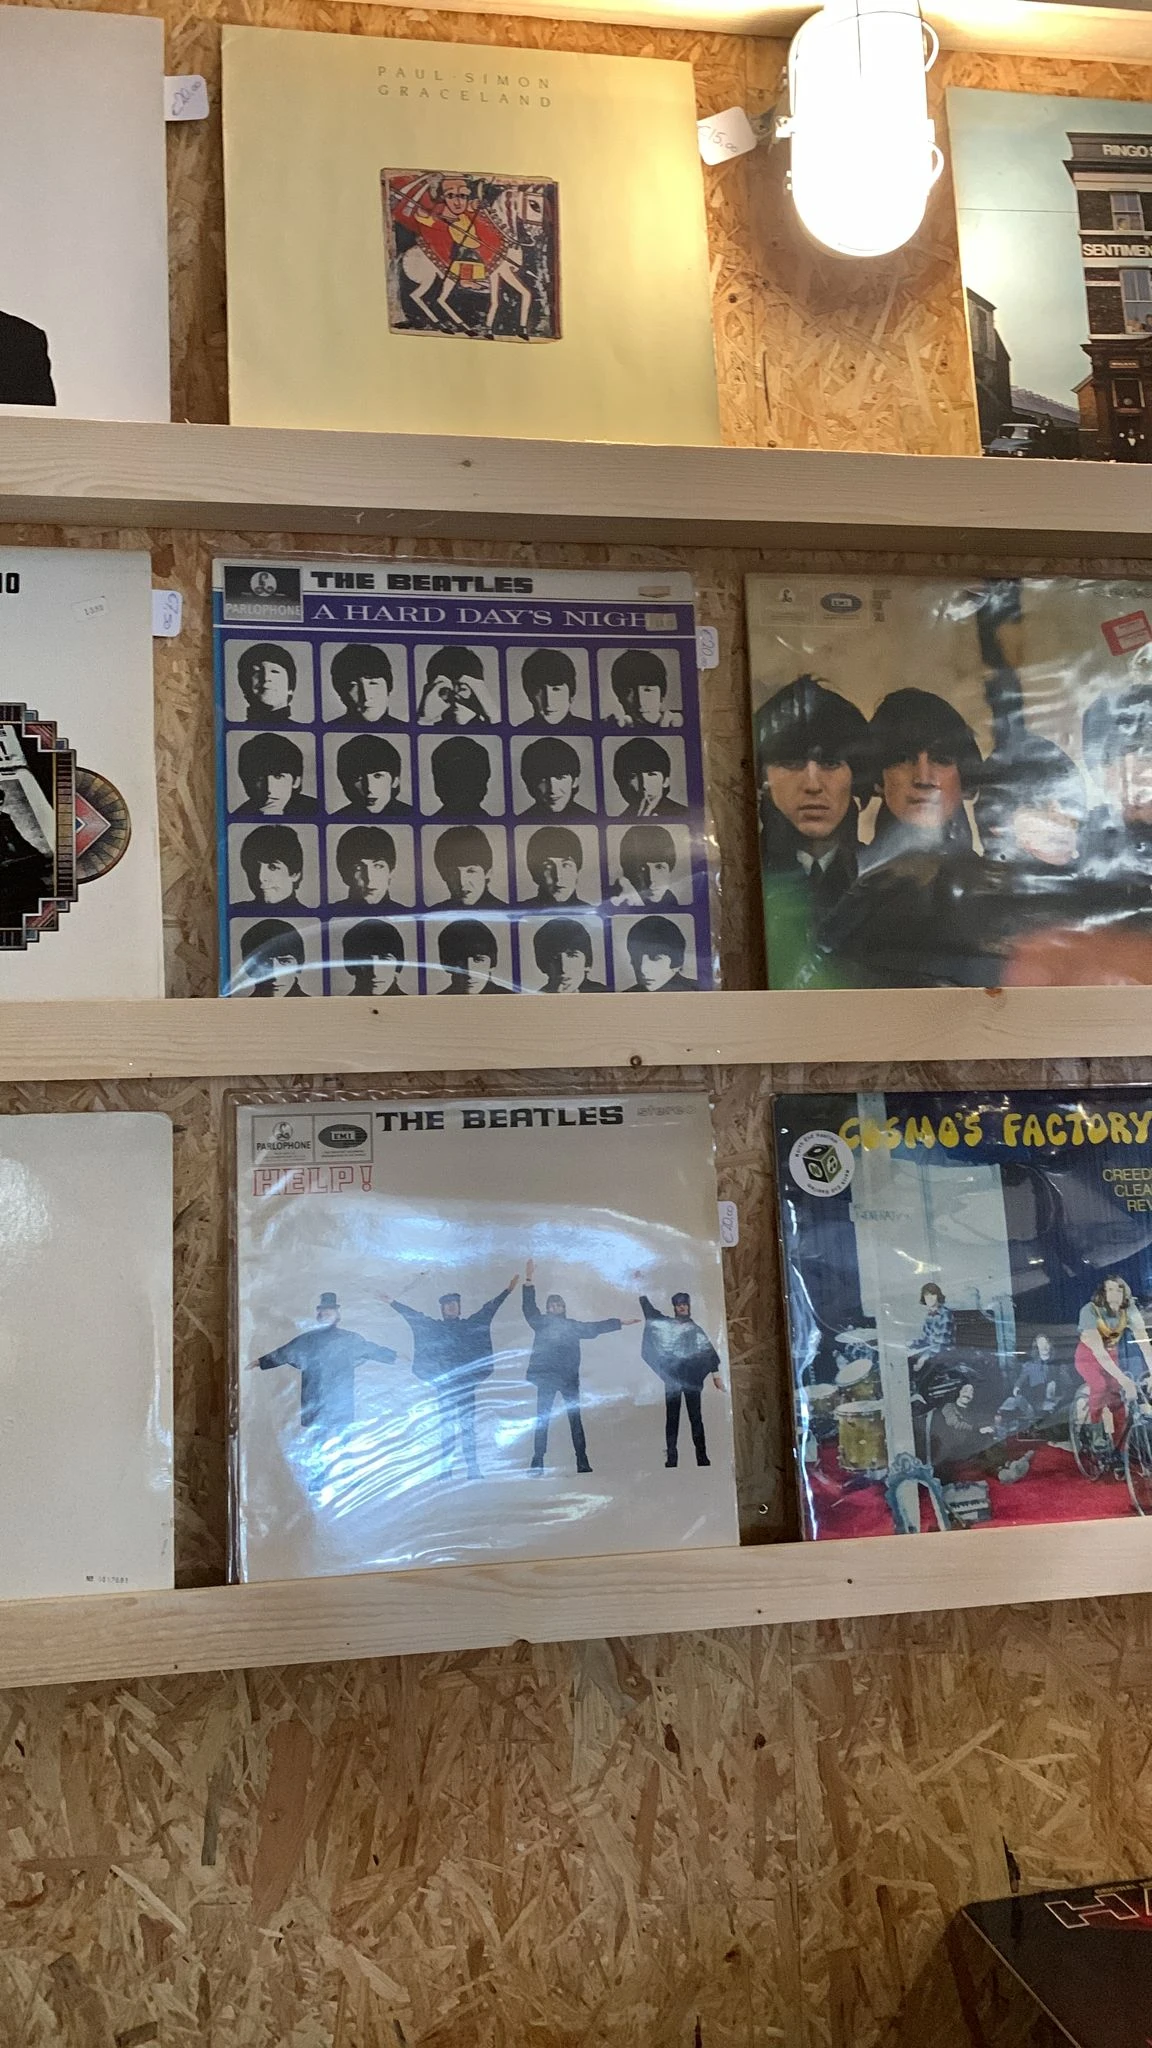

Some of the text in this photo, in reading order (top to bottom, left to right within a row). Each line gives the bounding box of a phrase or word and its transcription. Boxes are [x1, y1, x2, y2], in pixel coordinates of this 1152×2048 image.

[377, 65, 549, 88] PAUL SIMON
[377, 84, 551, 107] GRACELAND
[1102, 144, 1149, 157] RINGO
[310, 571, 533, 593] THE BEATLES
[226, 602, 301, 617] PARLOPHONE
[310, 603, 340, 620] A
[344, 604, 447, 623] HARD
[456, 608, 553, 626] DAY'S
[563, 611, 647, 627] NIGH
[375, 1105, 624, 1132] THE BEATLES
[839, 1111, 1152, 1150] COSMO'S FACTORY
[256, 1141, 312, 1151] PARLOPHONE
[252, 1165, 373, 1197] HELP!
